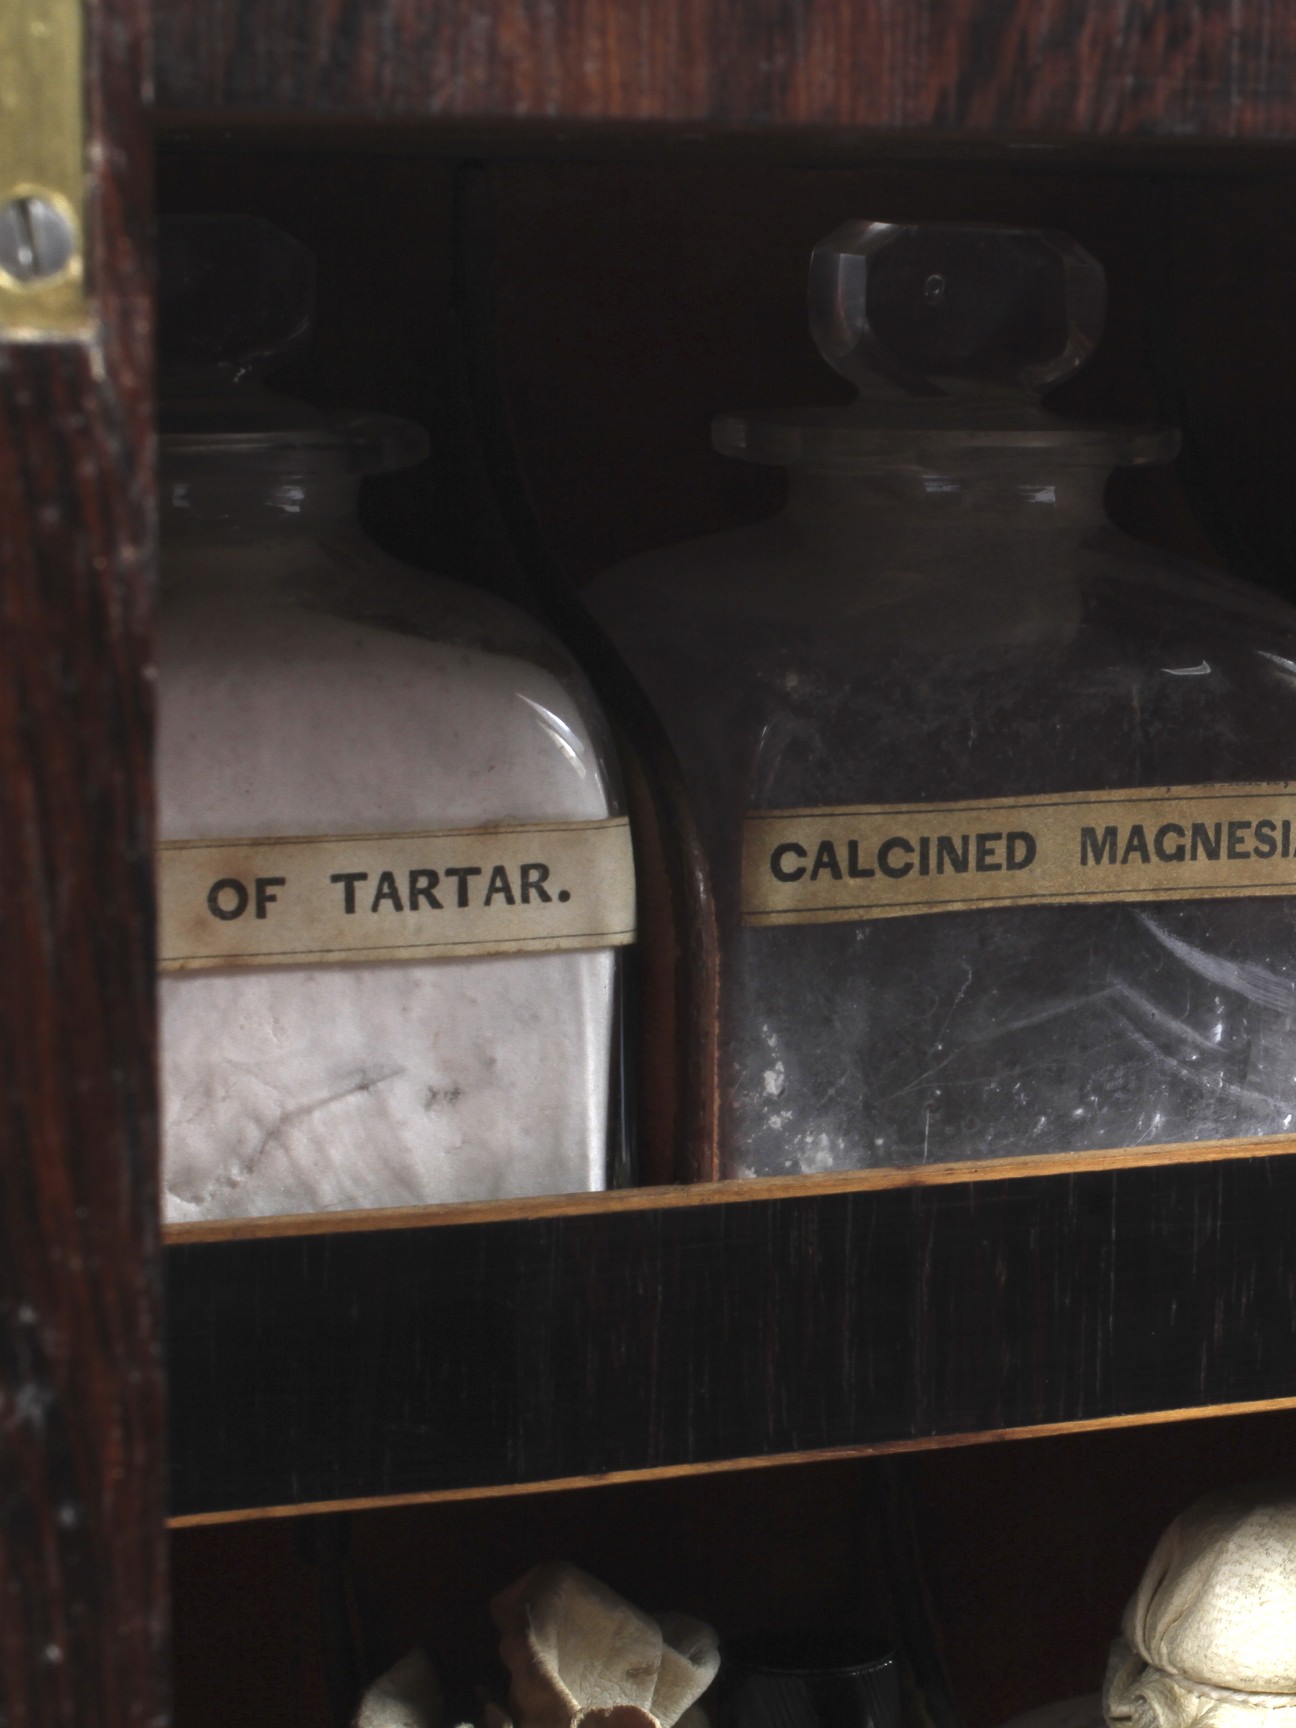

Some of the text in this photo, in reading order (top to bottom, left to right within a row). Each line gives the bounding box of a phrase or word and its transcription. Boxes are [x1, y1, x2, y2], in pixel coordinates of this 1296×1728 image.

[769, 830, 1037, 883] CALCINED
[206, 862, 571, 921] OF TARTAR.
